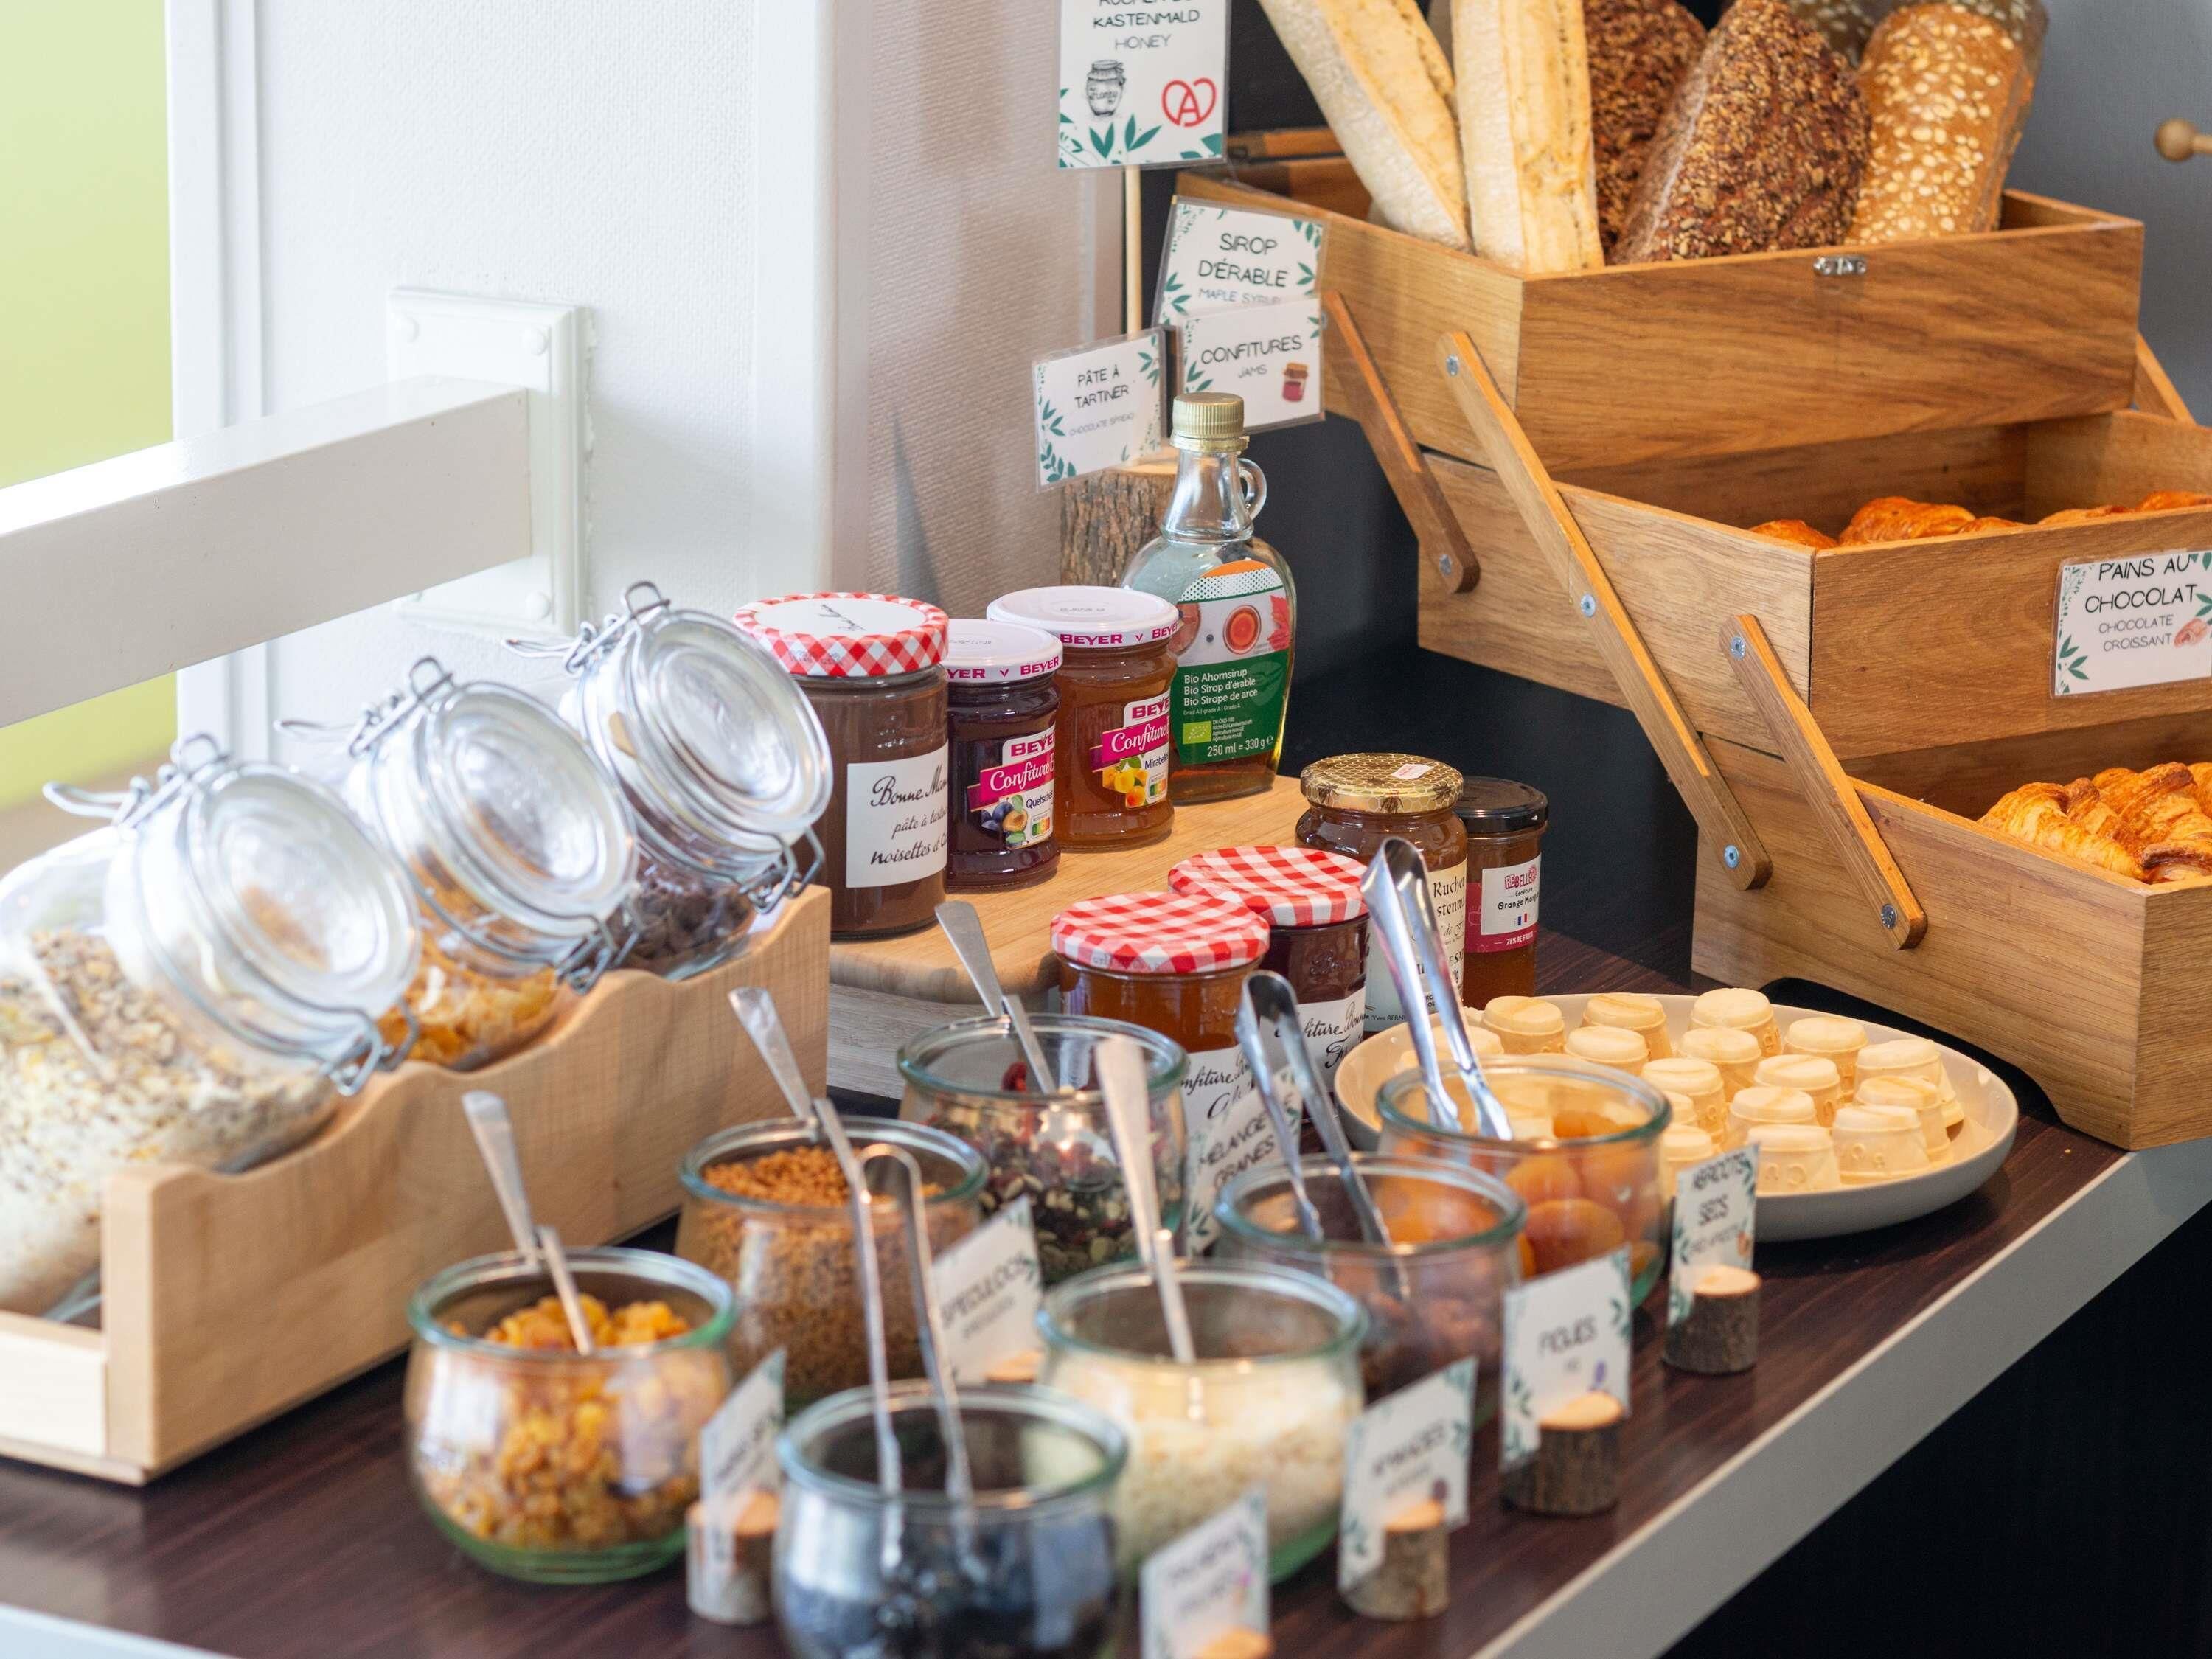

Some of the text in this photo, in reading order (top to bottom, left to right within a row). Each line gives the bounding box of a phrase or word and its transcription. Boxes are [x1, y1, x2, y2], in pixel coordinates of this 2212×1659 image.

[1114, 34, 1172, 50] HONEY
[1219, 232, 1279, 255] SIROP
[1198, 258, 1288, 288] D'ÉRABLE
[1199, 288, 1238, 302] MAPLE
[1200, 335, 1303, 364] CONFITURES
[1077, 368, 1107, 388] PÂTE
[1238, 364, 1267, 378] JAMS
[1074, 384, 1130, 410] TARTINER
[2098, 554, 2191, 582] PAINS AU
[2084, 583, 2198, 613] CHOCOLAT
[2098, 614, 2174, 634] CHOCOLATE
[1060, 633, 1123, 646] BEYER
[2103, 633, 2172, 653] CROISSANT
[947, 669, 986, 679] YER
[1020, 656, 1060, 675] BEYER
[1184, 669, 1248, 684] Bio Ahornsirup
[1184, 678, 1256, 695] Bio Sirop d'érable
[1183, 689, 1258, 706] Bio Sirope de arce
[1110, 723, 1167, 753] Confiture
[1208, 744, 1223, 757] 250
[1225, 742, 1237, 754] ml
[1245, 738, 1259, 750] 330
[1260, 739, 1266, 750] g
[990, 760, 1049, 791] Confiture
[870, 775, 924, 807] Bonne
[891, 815, 919, 840] pâte
[870, 839, 931, 866] noisettes
[1433, 876, 1465, 898] Rucher
[1498, 900, 1524, 910] Orange
[1181, 1065, 1234, 1096] nfiture
